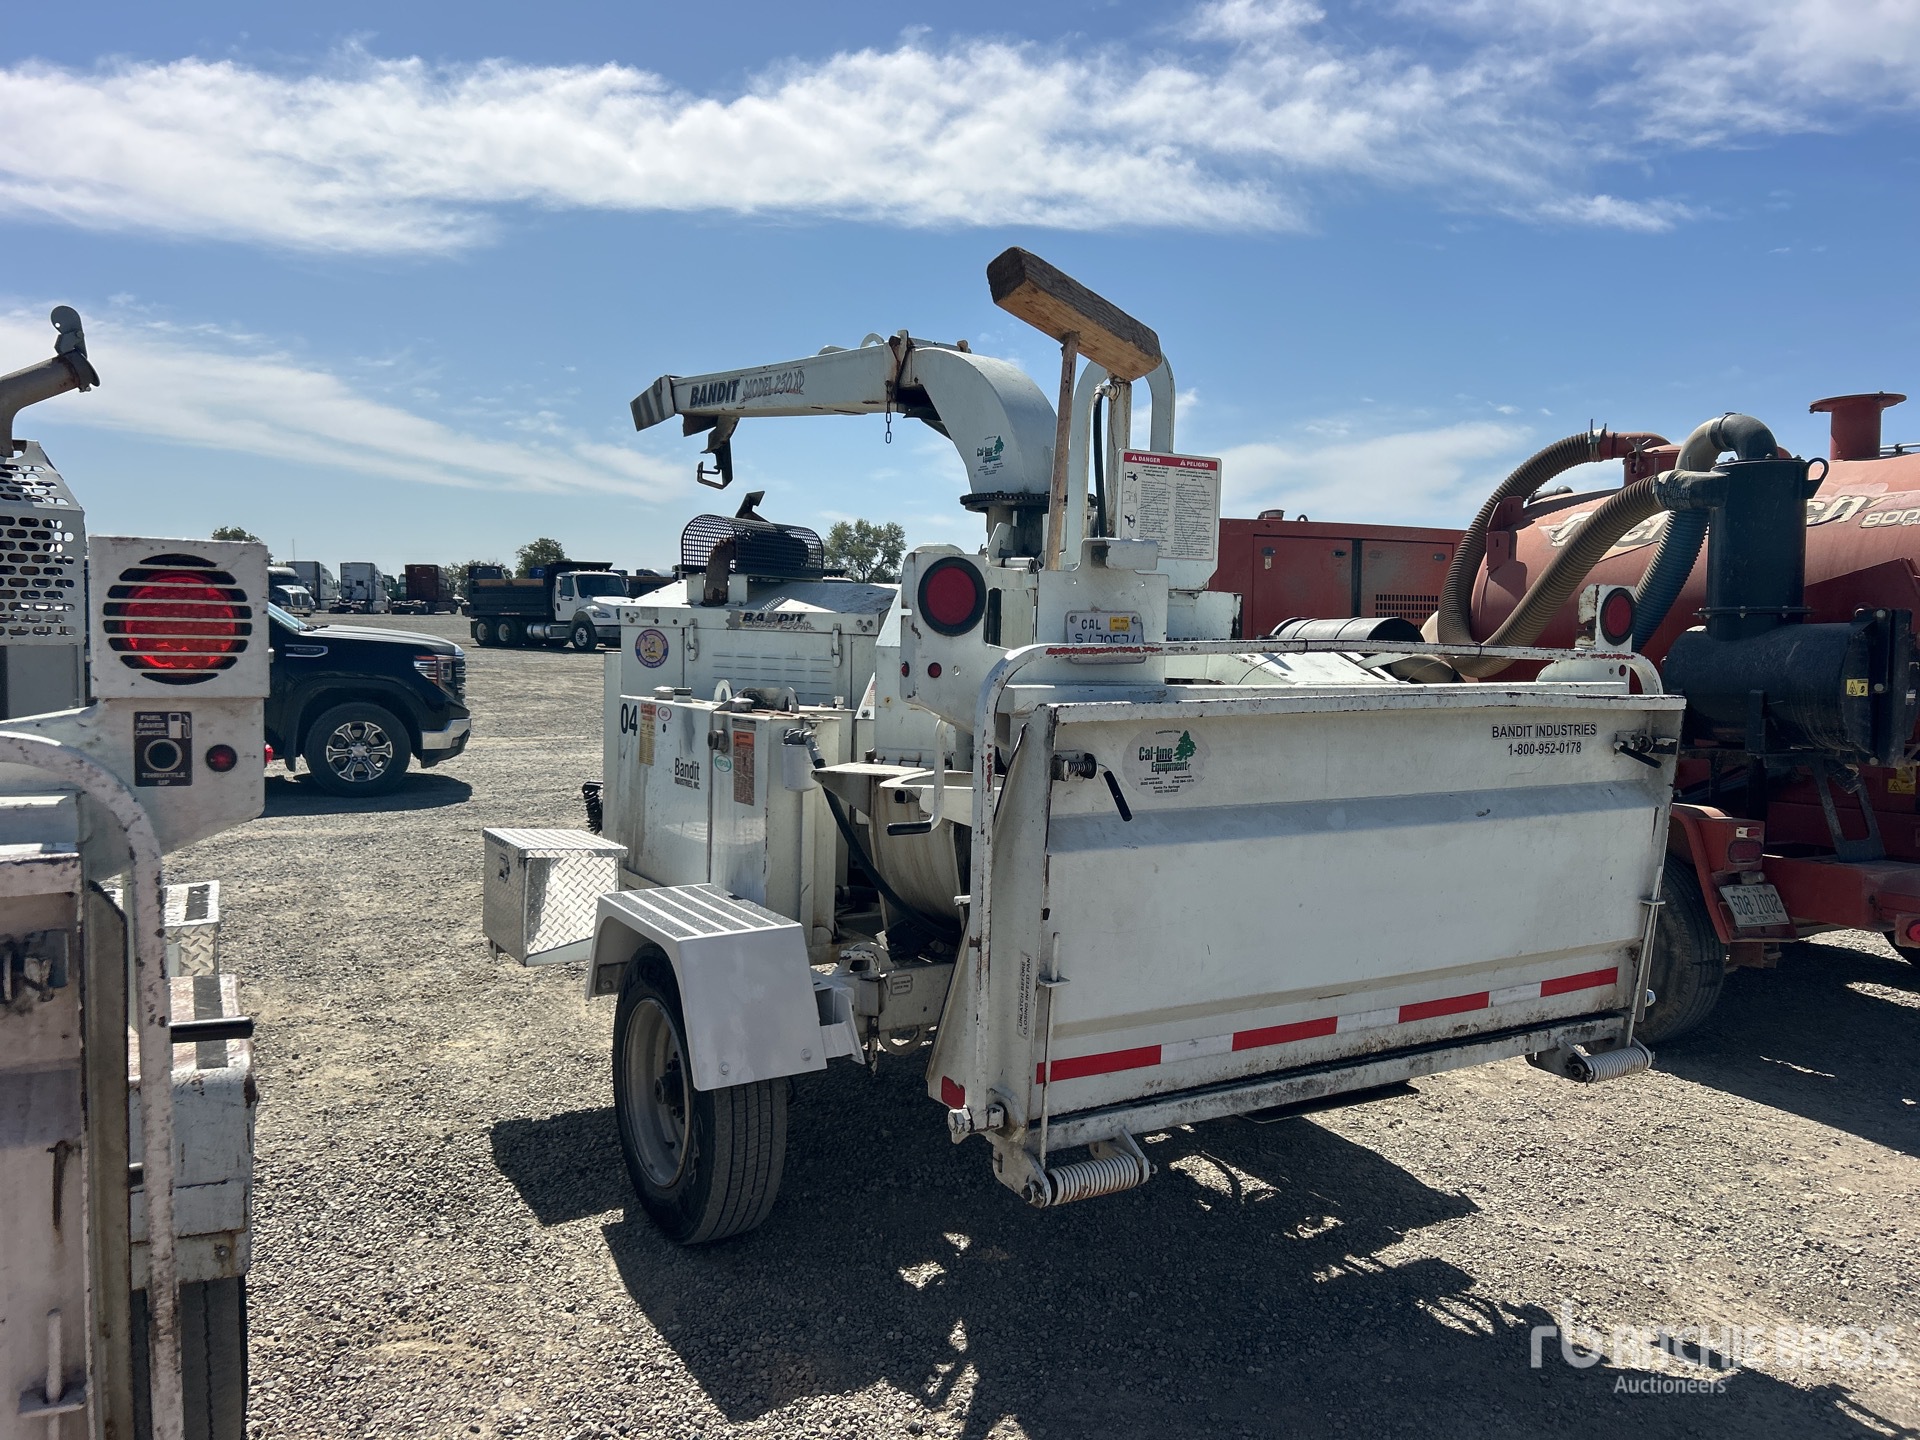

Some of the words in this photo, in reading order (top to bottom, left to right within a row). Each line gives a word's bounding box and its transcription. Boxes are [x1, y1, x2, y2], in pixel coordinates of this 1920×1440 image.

[690, 379, 740, 408] BANDIT
[1138, 456, 1161, 464] DANGER
[1186, 460, 1209, 468] PELIGRO
[742, 612, 806, 622] BADIT
[1081, 619, 1101, 630] CAL
[621, 703, 638, 737] 04
[1492, 725, 1533, 738] BANDIT
[1536, 723, 1597, 737] INDUSTRIES
[1508, 741, 1582, 756] 1-800-952-0178
[674, 757, 700, 781] Bandit
[1151, 761, 1188, 774] Equipment
